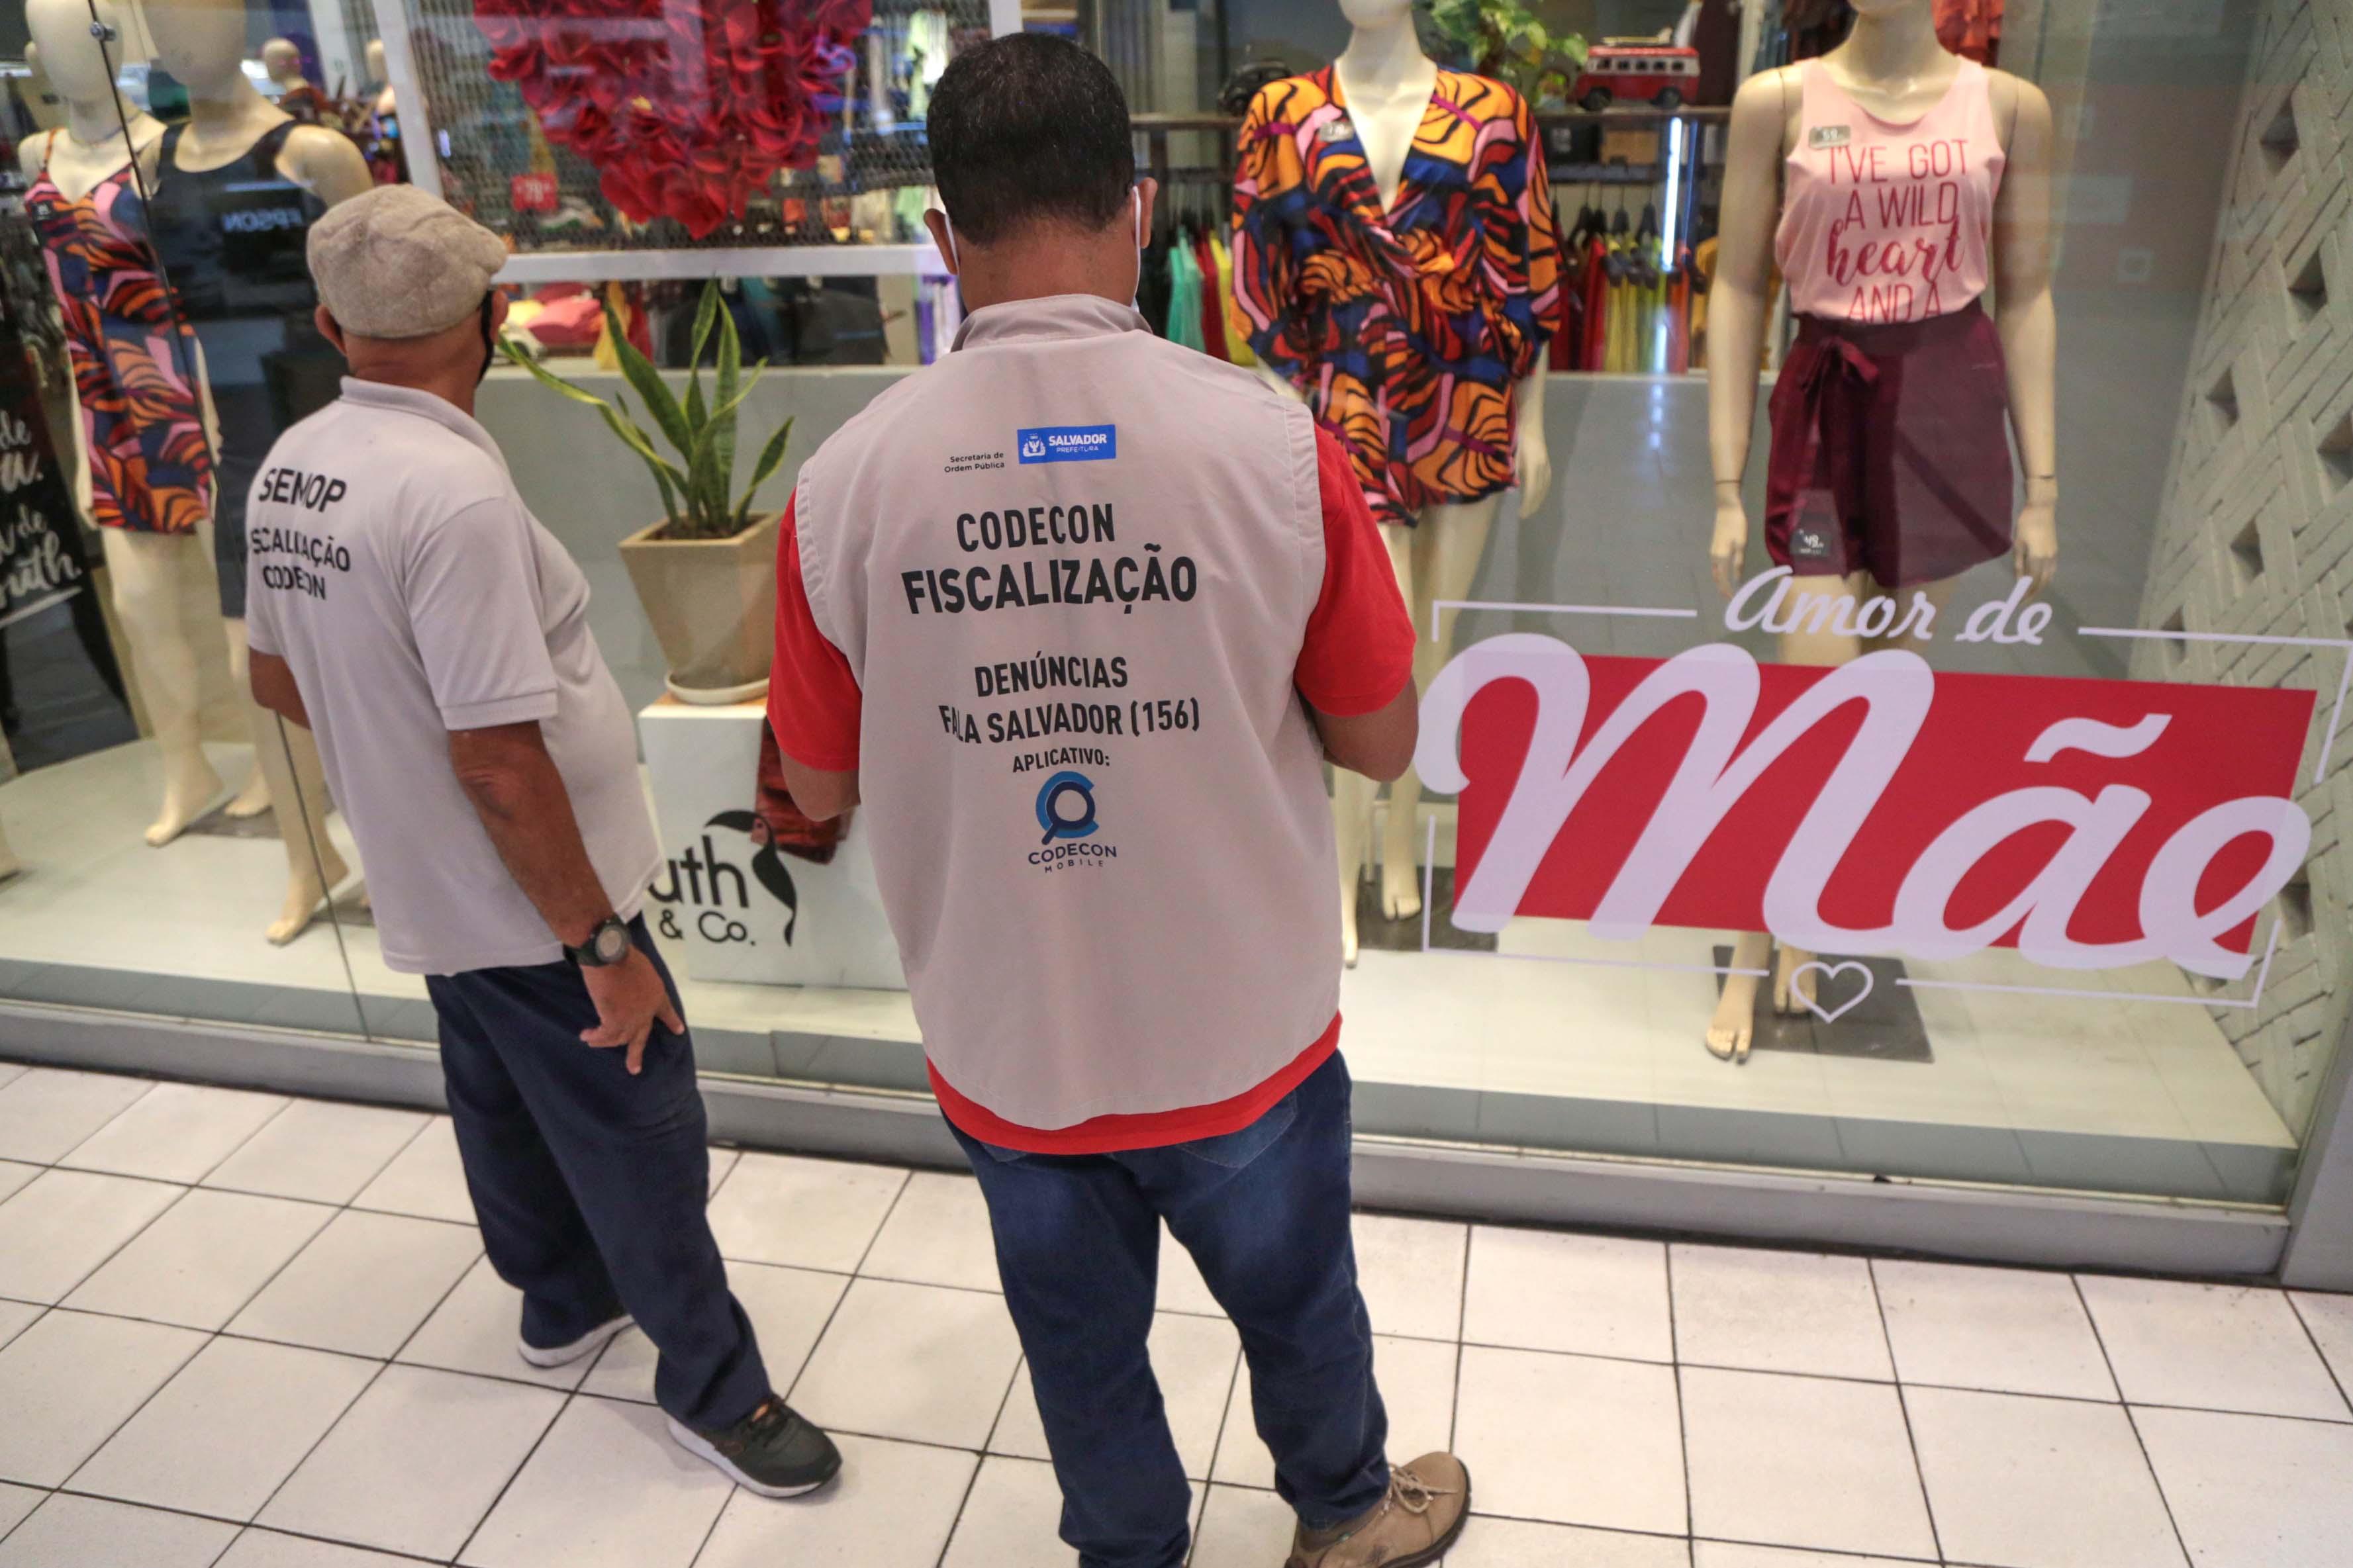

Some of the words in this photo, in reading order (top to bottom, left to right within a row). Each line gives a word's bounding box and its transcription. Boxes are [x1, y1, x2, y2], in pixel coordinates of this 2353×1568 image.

[1830, 146, 1888, 184] I'VE
[1909, 138, 1968, 179] GOT
[1844, 189, 1866, 232] A
[1878, 181, 1958, 229] WILD
[1827, 213, 1966, 287] heart
[1848, 283, 1913, 324] AND
[1924, 281, 1941, 319] A
[950, 454, 991, 463] Secretaria
[1049, 434, 1107, 446] SALVADOR
[944, 464, 973, 473] Ordem
[957, 503, 1115, 552] CODECON
[901, 543, 1197, 615] FISCALIZAÇÃO
[1725, 565, 1937, 641] Amor
[1954, 576, 2052, 645] de
[975, 651, 1128, 697] DENÚNCIAS
[987, 702, 1124, 743] SALVADOR
[1130, 697, 1200, 737] (156)
[1013, 747, 1110, 772] APLICATIVO:
[1413, 633, 2312, 980] Mãe
[1028, 843, 1118, 864] CODECON
[1045, 858, 1104, 873] MOBILE
[659, 909, 683, 939] &
[698, 911, 755, 946] Co.
